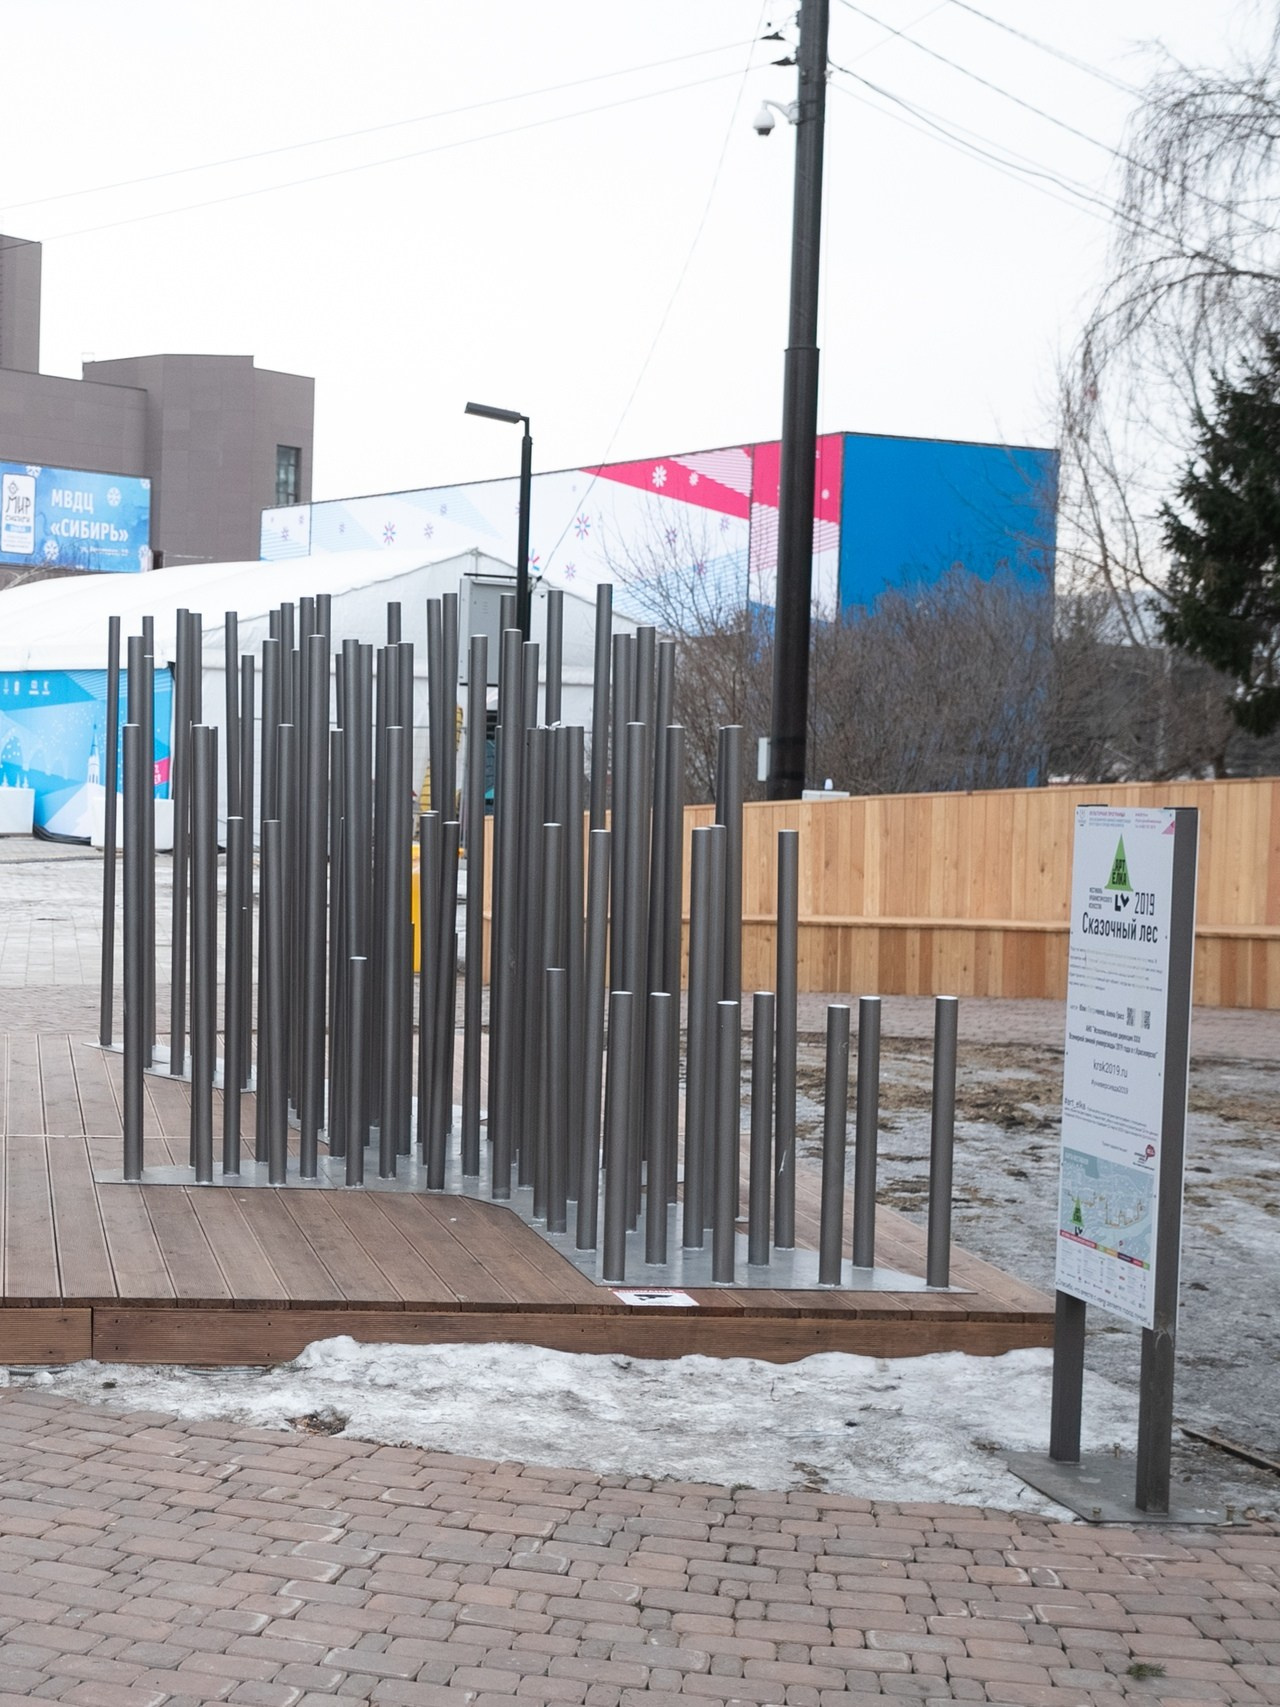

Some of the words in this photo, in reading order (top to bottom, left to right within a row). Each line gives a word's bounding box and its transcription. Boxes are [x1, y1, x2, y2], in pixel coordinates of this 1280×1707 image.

[5, 495, 32, 514] МИР
[51, 488, 94, 515] МВДЦ
[50, 519, 129, 543] «СИБИРЬ»
[1134, 892, 1155, 916] 2019
[1082, 912, 1137, 941] Сказочный
[1139, 924, 1158, 943] лес
[1093, 1059, 1128, 1078] krsk2019.ru
